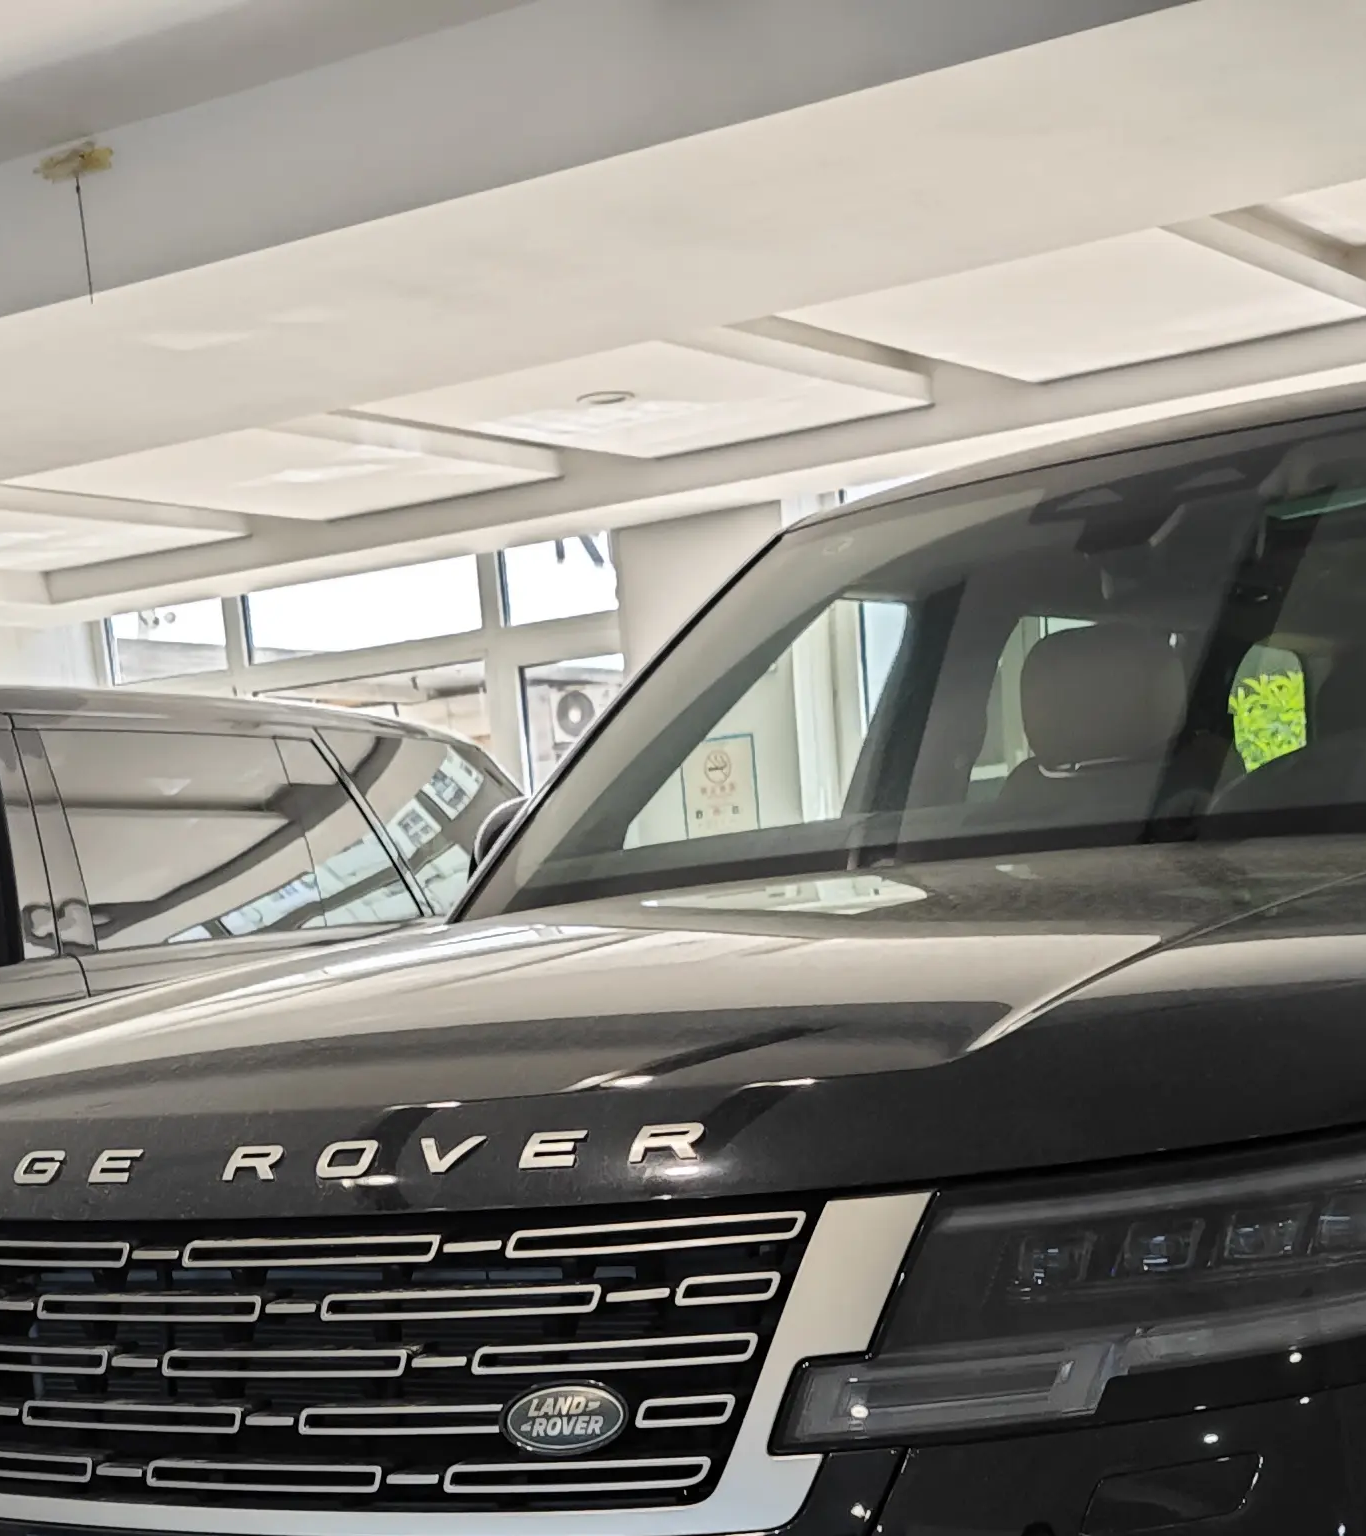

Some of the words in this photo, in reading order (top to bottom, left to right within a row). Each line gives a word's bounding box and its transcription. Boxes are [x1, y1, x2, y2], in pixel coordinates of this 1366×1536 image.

[222, 1122, 704, 1181] ROVER
[528, 1396, 586, 1417] LAND
[532, 1416, 604, 1437] ROVER
